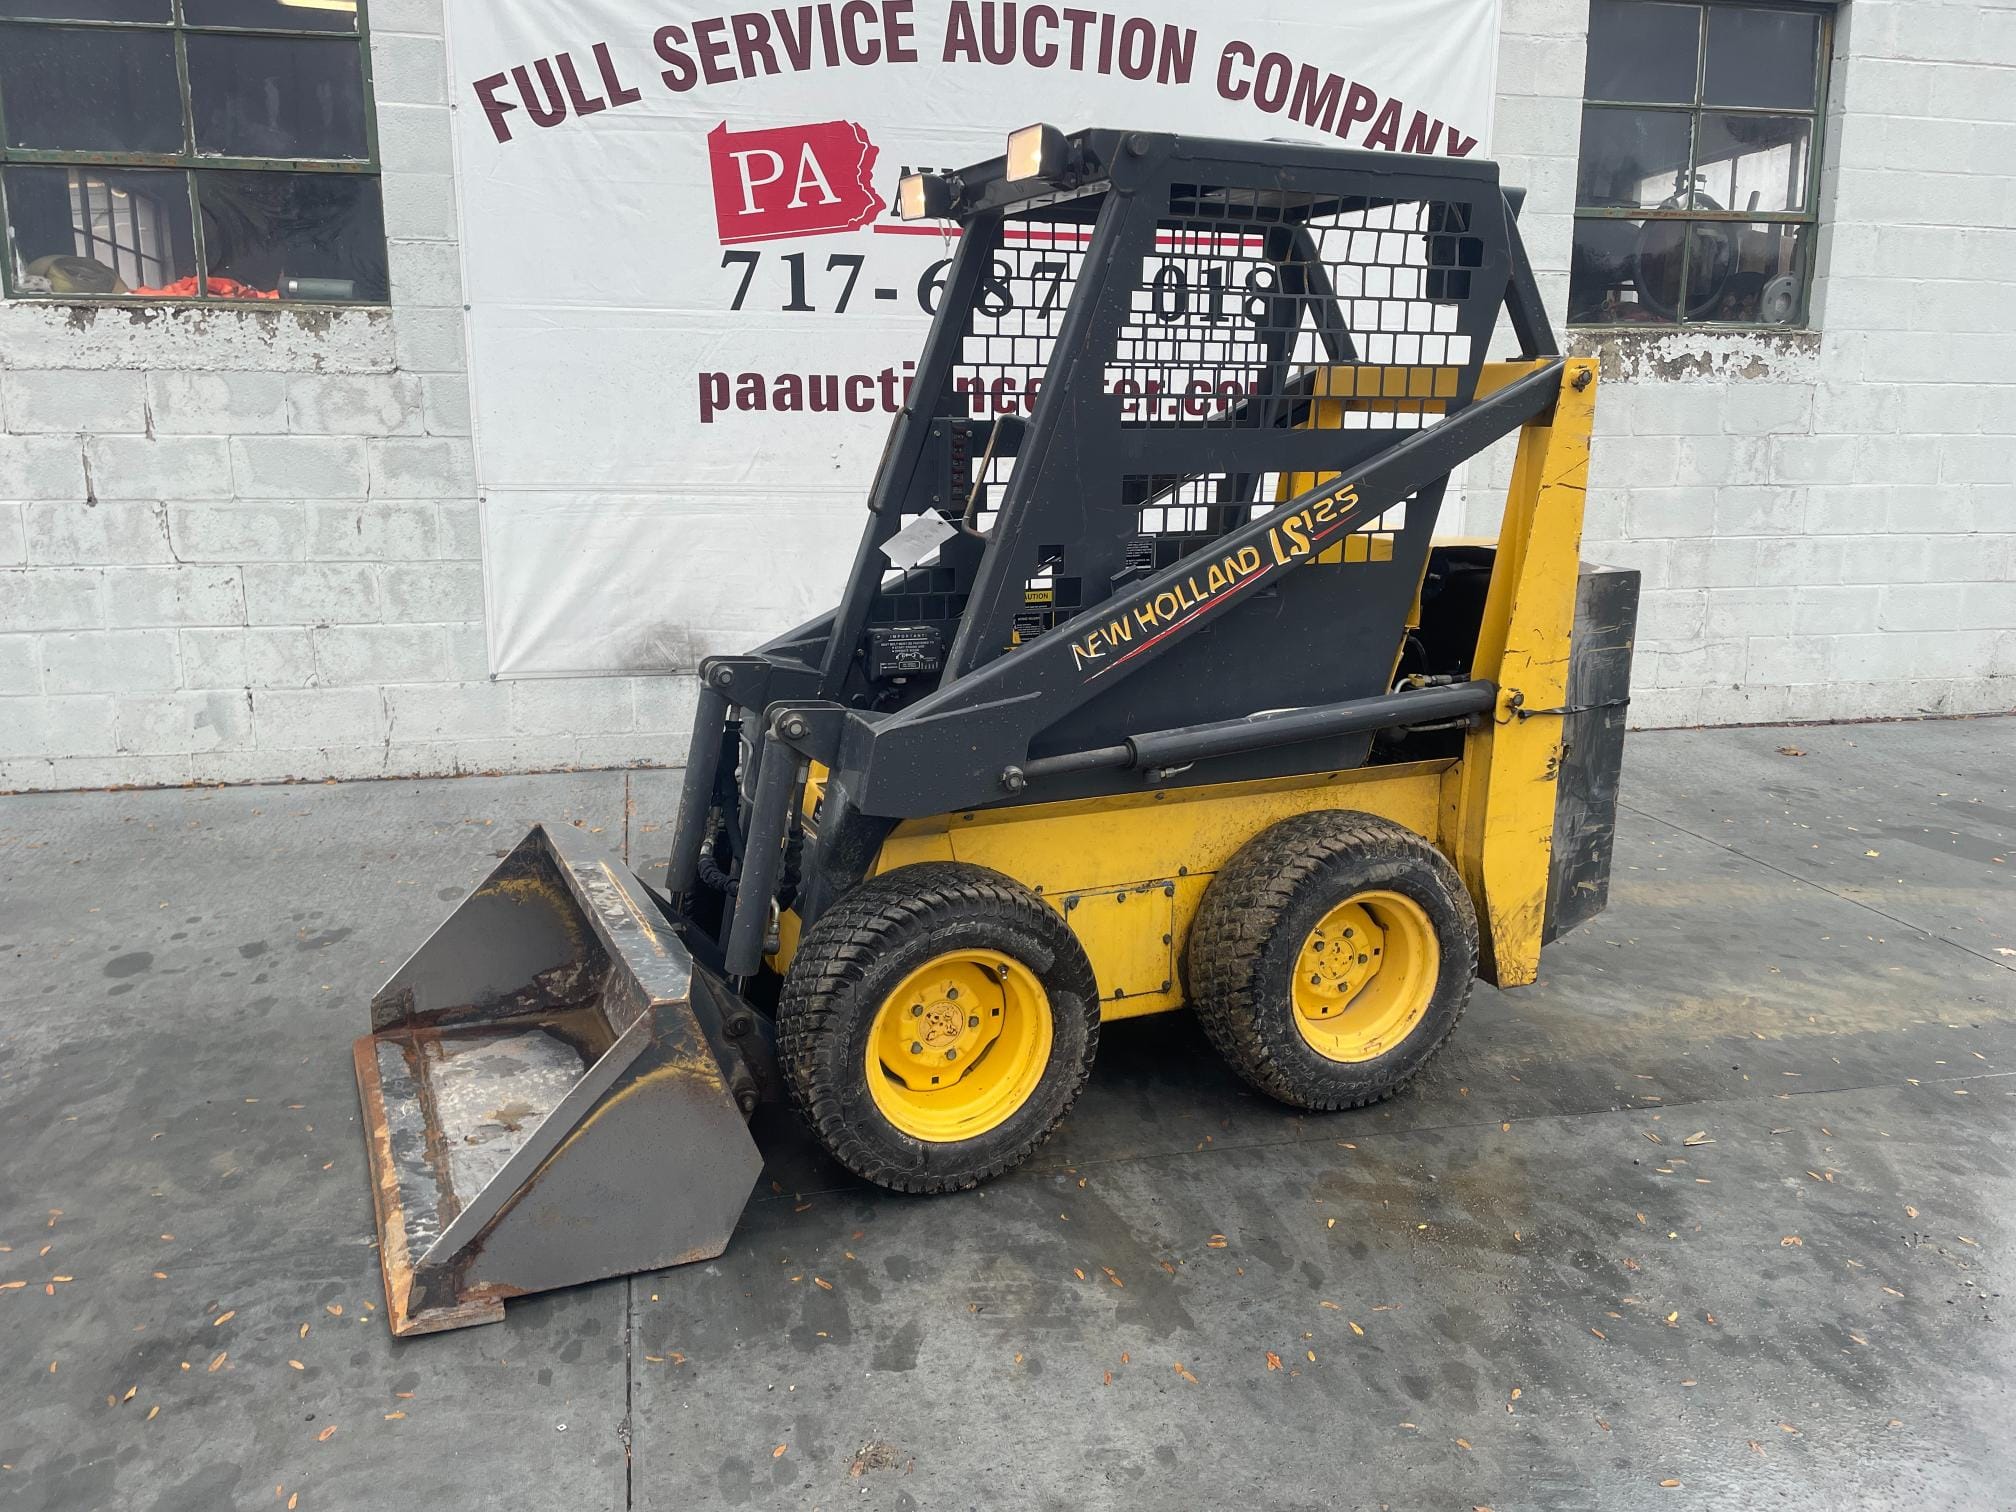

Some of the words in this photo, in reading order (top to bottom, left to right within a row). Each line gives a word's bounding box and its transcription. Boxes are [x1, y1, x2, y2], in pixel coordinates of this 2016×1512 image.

[472, 42, 642, 144] FULL
[653, 0, 918, 93] SERVICE
[942, 0, 1198, 85] AUCTION
[1216, 40, 1478, 158] COMPANY
[729, 142, 842, 216] PA
[1072, 614, 1133, 672] NEW
[1134, 545, 1262, 634] HOLLAND
